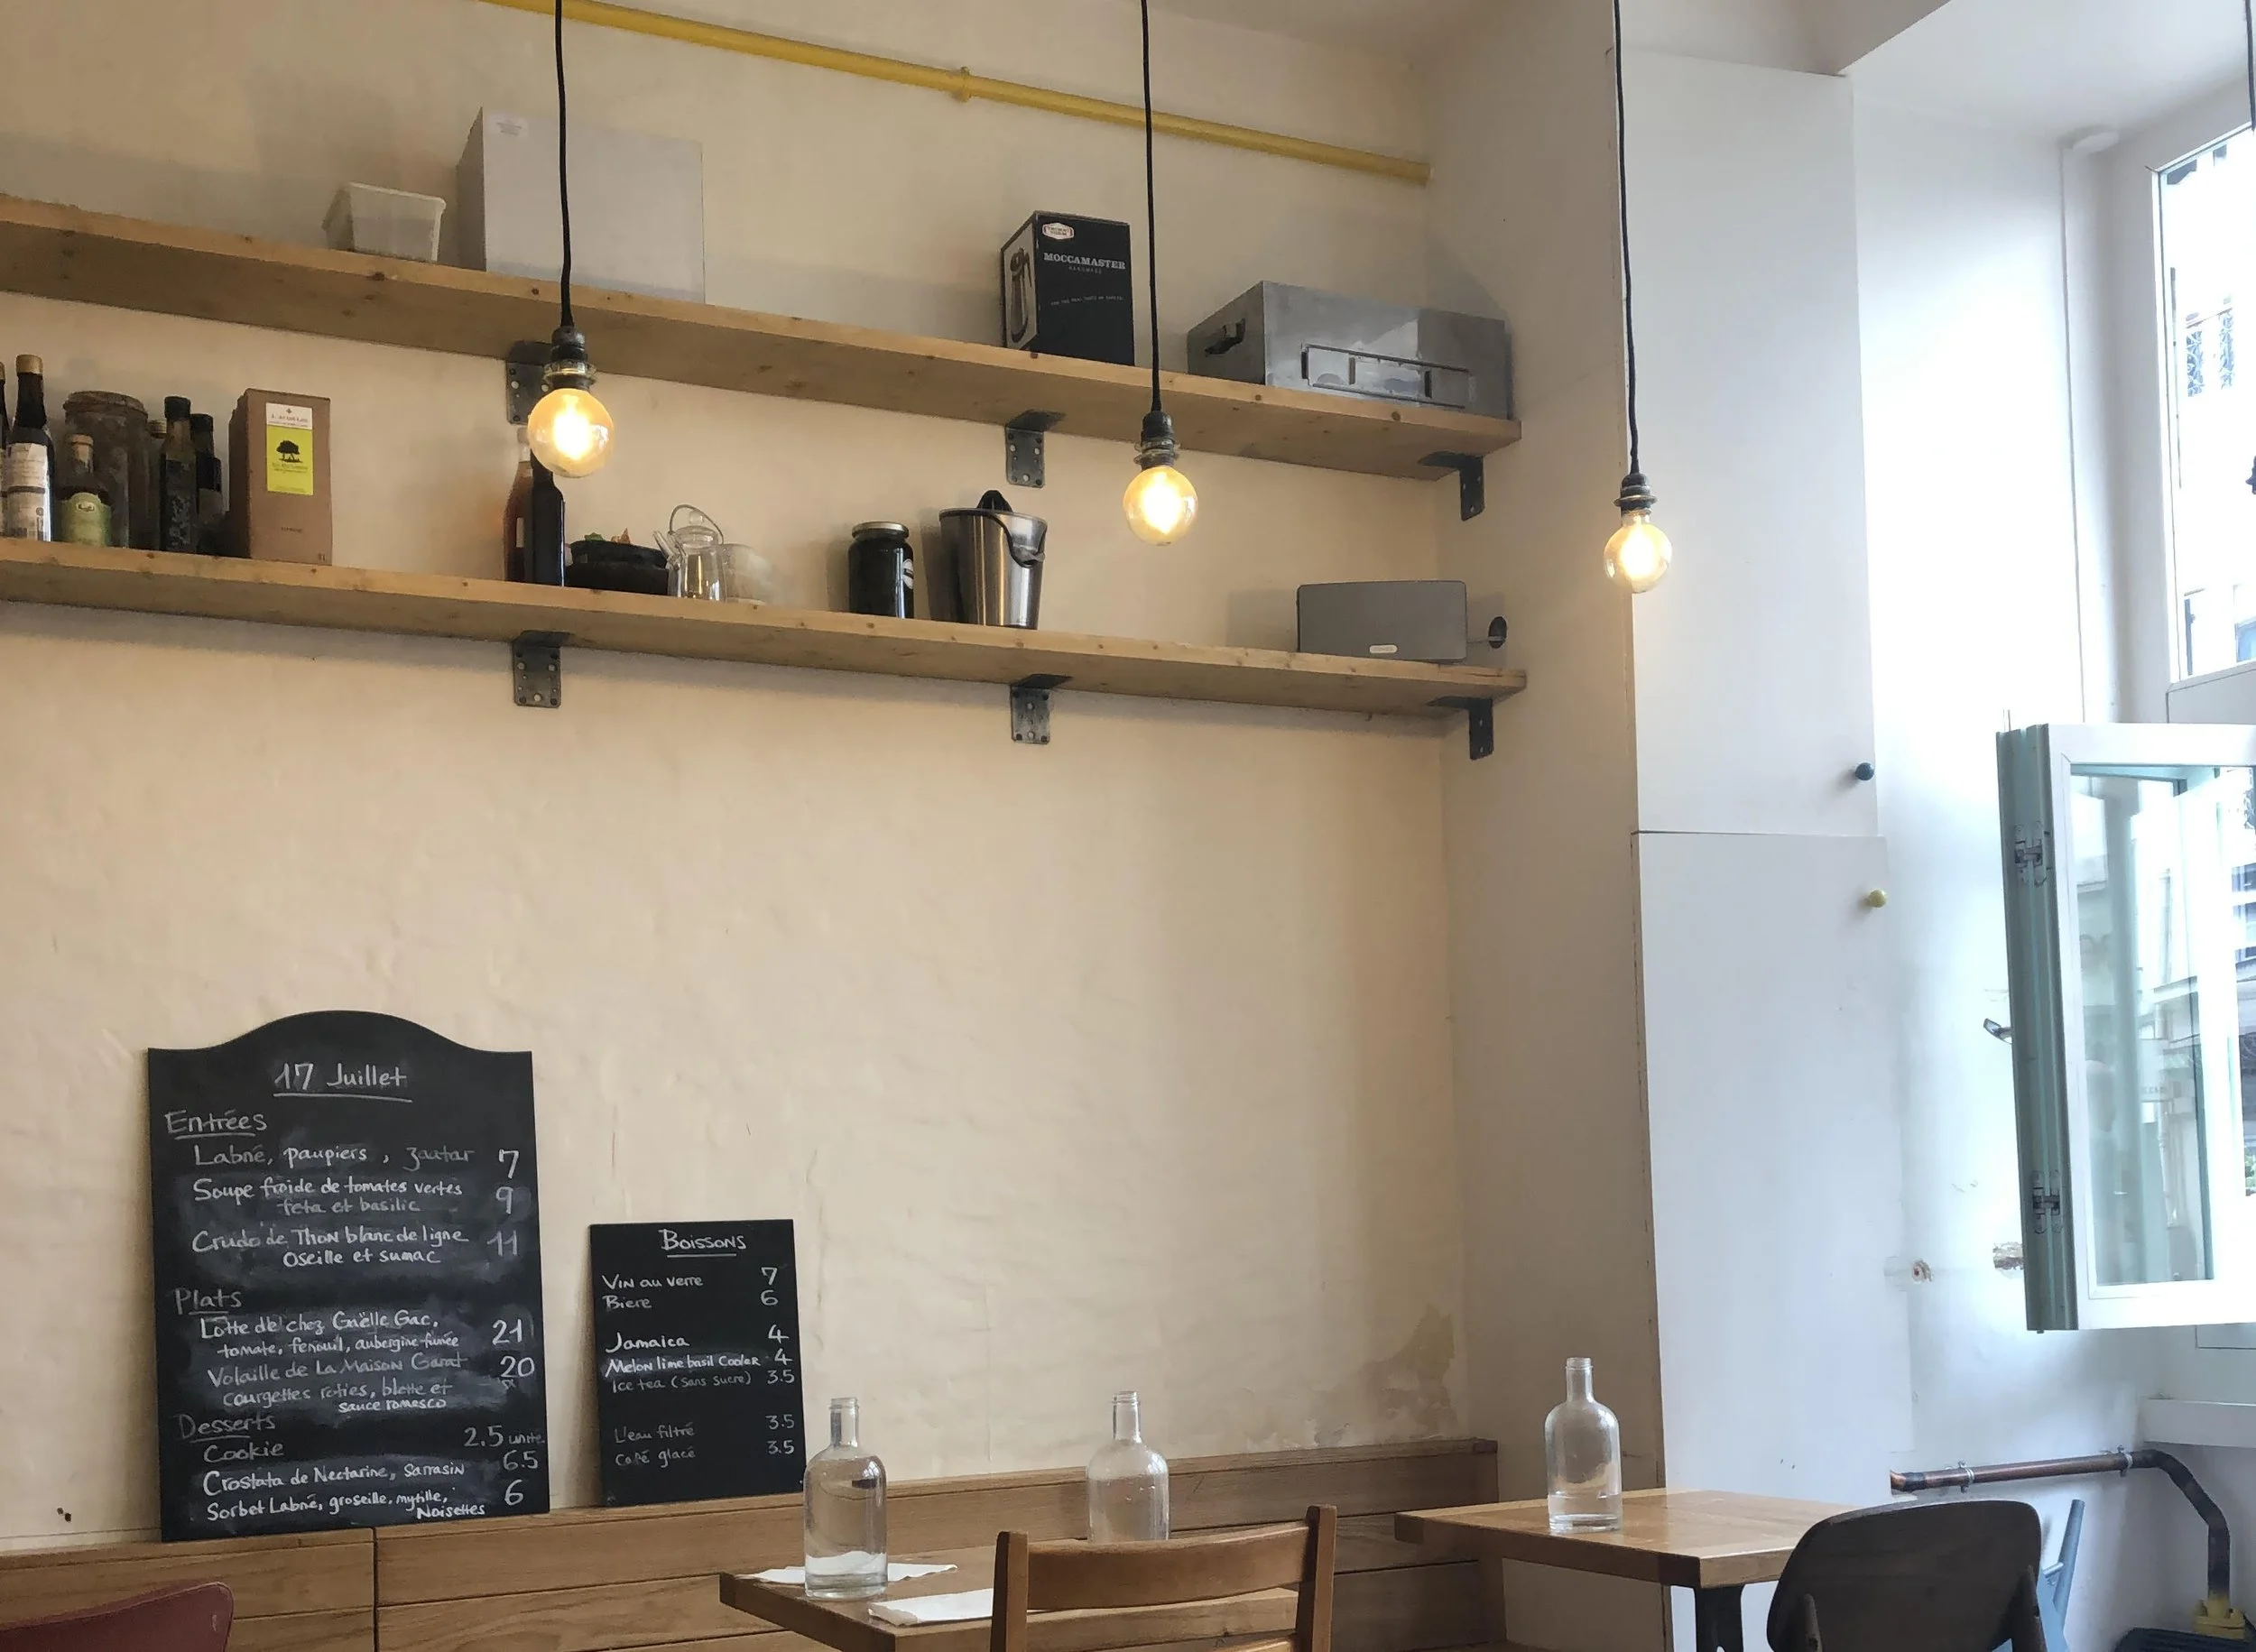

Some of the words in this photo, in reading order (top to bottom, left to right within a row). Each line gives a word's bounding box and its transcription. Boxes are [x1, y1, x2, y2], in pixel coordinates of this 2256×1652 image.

[1043, 253, 1126, 269] MOCCAMASTER
[274, 1063, 314, 1090] 17
[327, 1063, 407, 1088] Juillet
[164, 1109, 268, 1134] Entrées
[498, 1149, 520, 1179] 7
[193, 1177, 254, 1205] Soupe
[260, 1176, 316, 1198] froide
[320, 1177, 340, 1194] de
[344, 1176, 407, 1194] tomates
[414, 1180, 463, 1196] vertes
[495, 1186, 514, 1214] 9
[276, 1198, 326, 1216] feta
[331, 1198, 353, 1213] et
[359, 1196, 421, 1212] basilic
[192, 1229, 261, 1252] Crudo
[266, 1227, 288, 1245] de
[345, 1225, 394, 1244] blanc
[397, 1226, 418, 1241] de
[422, 1224, 469, 1248] ligne
[486, 1230, 519, 1257] 11
[353, 1248, 374, 1263] et
[640, 1278, 662, 1288] au
[666, 1276, 704, 1287] verre
[760, 1266, 778, 1286] 7
[173, 1287, 243, 1315] Plats
[760, 1288, 779, 1306] 6
[200, 1317, 250, 1339] Lotte
[286, 1314, 326, 1335] chez
[491, 1319, 522, 1344] 21
[605, 1332, 690, 1353] Jamaica
[767, 1324, 790, 1344] 4
[355, 1334, 418, 1352] aubergine
[656, 1355, 684, 1370] lime
[687, 1354, 715, 1368] basil
[773, 1348, 794, 1365] 4
[208, 1364, 280, 1389] Volaille
[285, 1361, 309, 1378] de
[500, 1355, 535, 1379] 20
[612, 1380, 633, 1393] Ice
[639, 1377, 666, 1390] tea
[766, 1370, 795, 1385] 3.5
[430, 1378, 453, 1396] et
[338, 1401, 381, 1413] sauce
[385, 1398, 447, 1411] romesco
[173, 1413, 276, 1439] Desserts
[764, 1414, 796, 1430] 3.5
[203, 1441, 284, 1463] Cookie
[463, 1425, 504, 1448] 2.5
[766, 1439, 796, 1455] 3.5
[202, 1470, 284, 1497] Crostata
[290, 1467, 310, 1486] de
[503, 1449, 539, 1472] 6.5
[207, 1500, 266, 1522] Sorbet
[504, 1479, 524, 1507] 6
[416, 1504, 486, 1519] Noisettes
